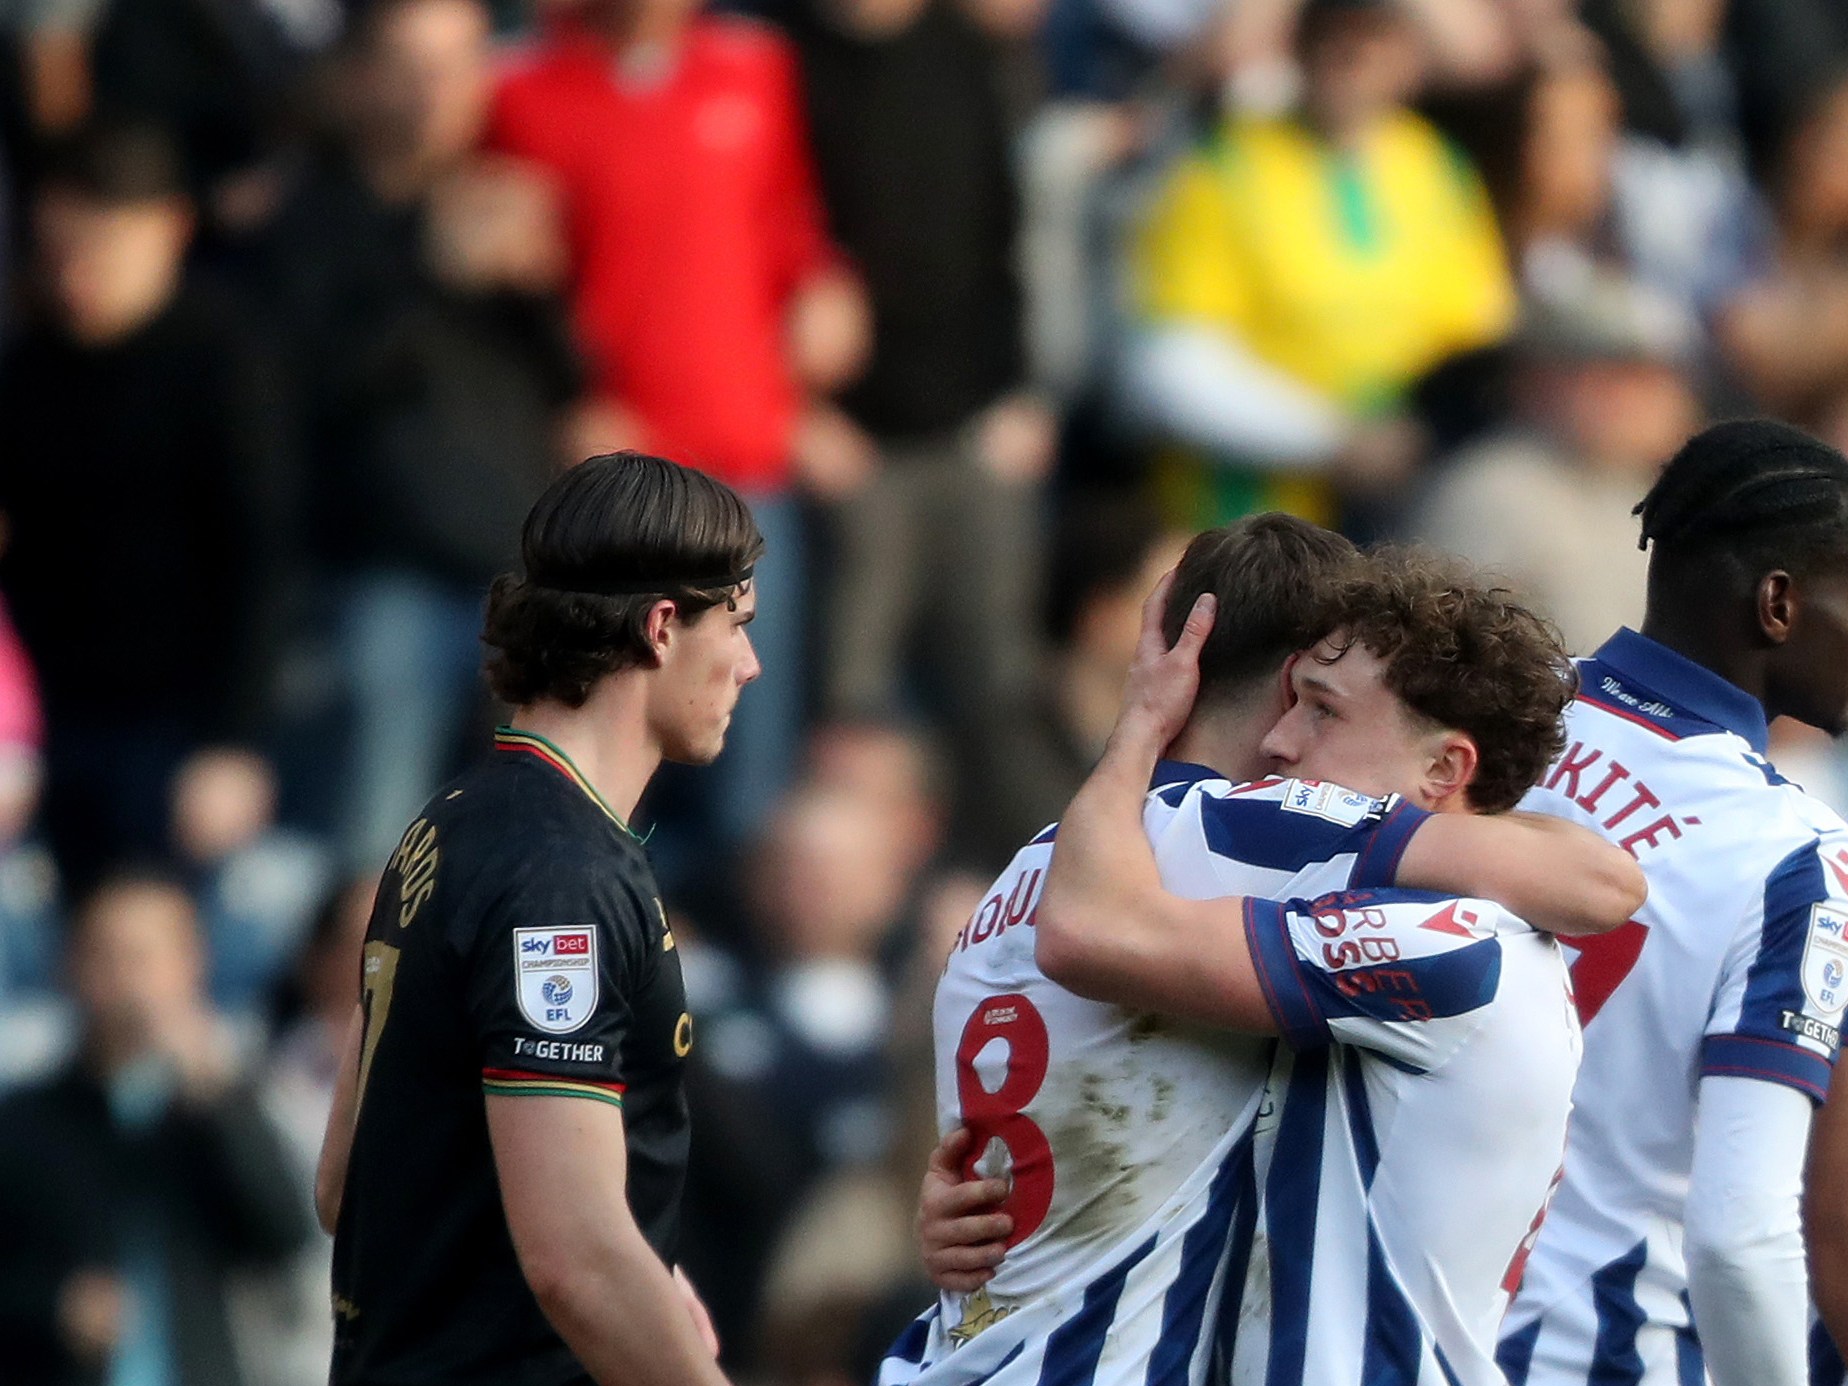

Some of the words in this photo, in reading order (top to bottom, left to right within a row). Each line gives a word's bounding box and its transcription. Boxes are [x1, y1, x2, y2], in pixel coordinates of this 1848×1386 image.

[1535, 740, 1702, 862] KITÉ
[389, 817, 440, 929] ARDS
[521, 936, 551, 955] sky
[557, 936, 586, 950] bet
[1817, 916, 1843, 935] sky
[546, 1008, 572, 1022] EFL
[957, 994, 1055, 1254] 8
